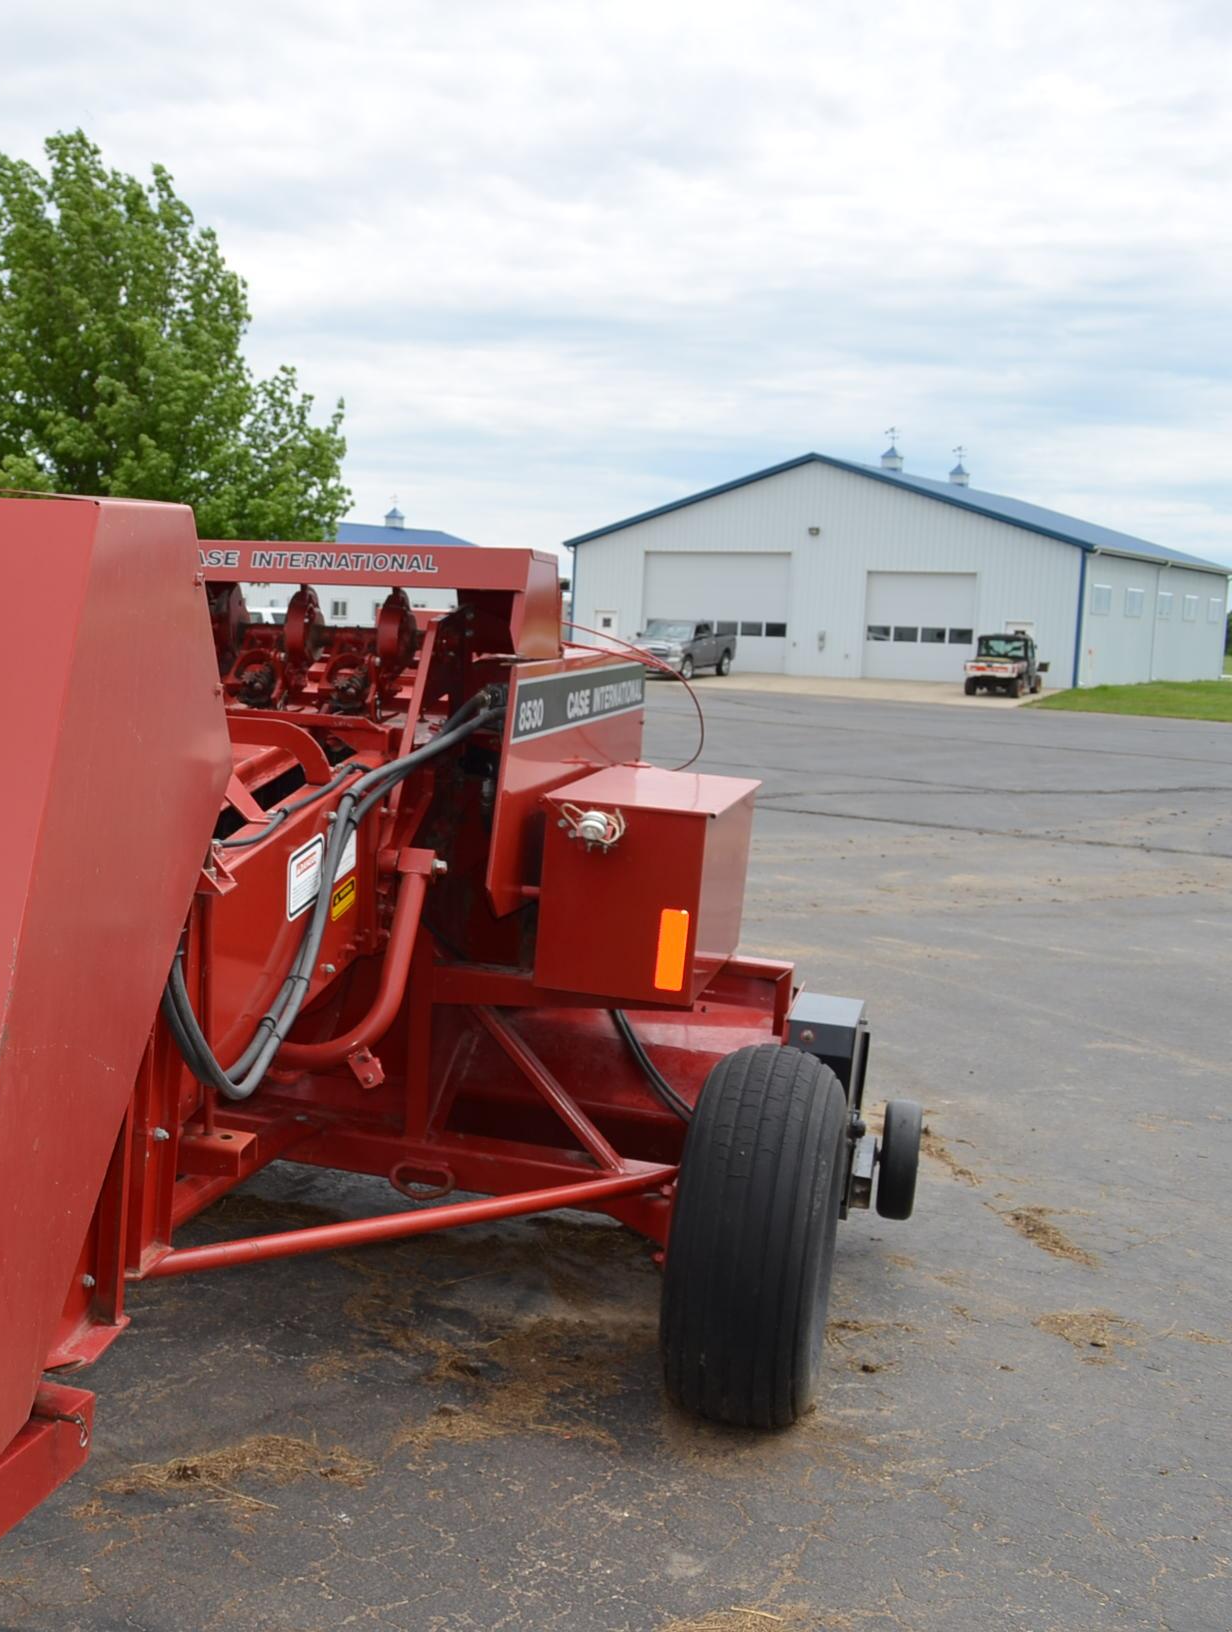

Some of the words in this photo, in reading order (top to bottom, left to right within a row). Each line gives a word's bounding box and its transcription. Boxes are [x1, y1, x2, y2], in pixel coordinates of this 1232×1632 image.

[250, 552, 438, 573] INTERNATIONAL
[518, 698, 545, 732] 8530
[567, 689, 591, 720] CASE
[592, 679, 642, 713] INTERNATIONAL
